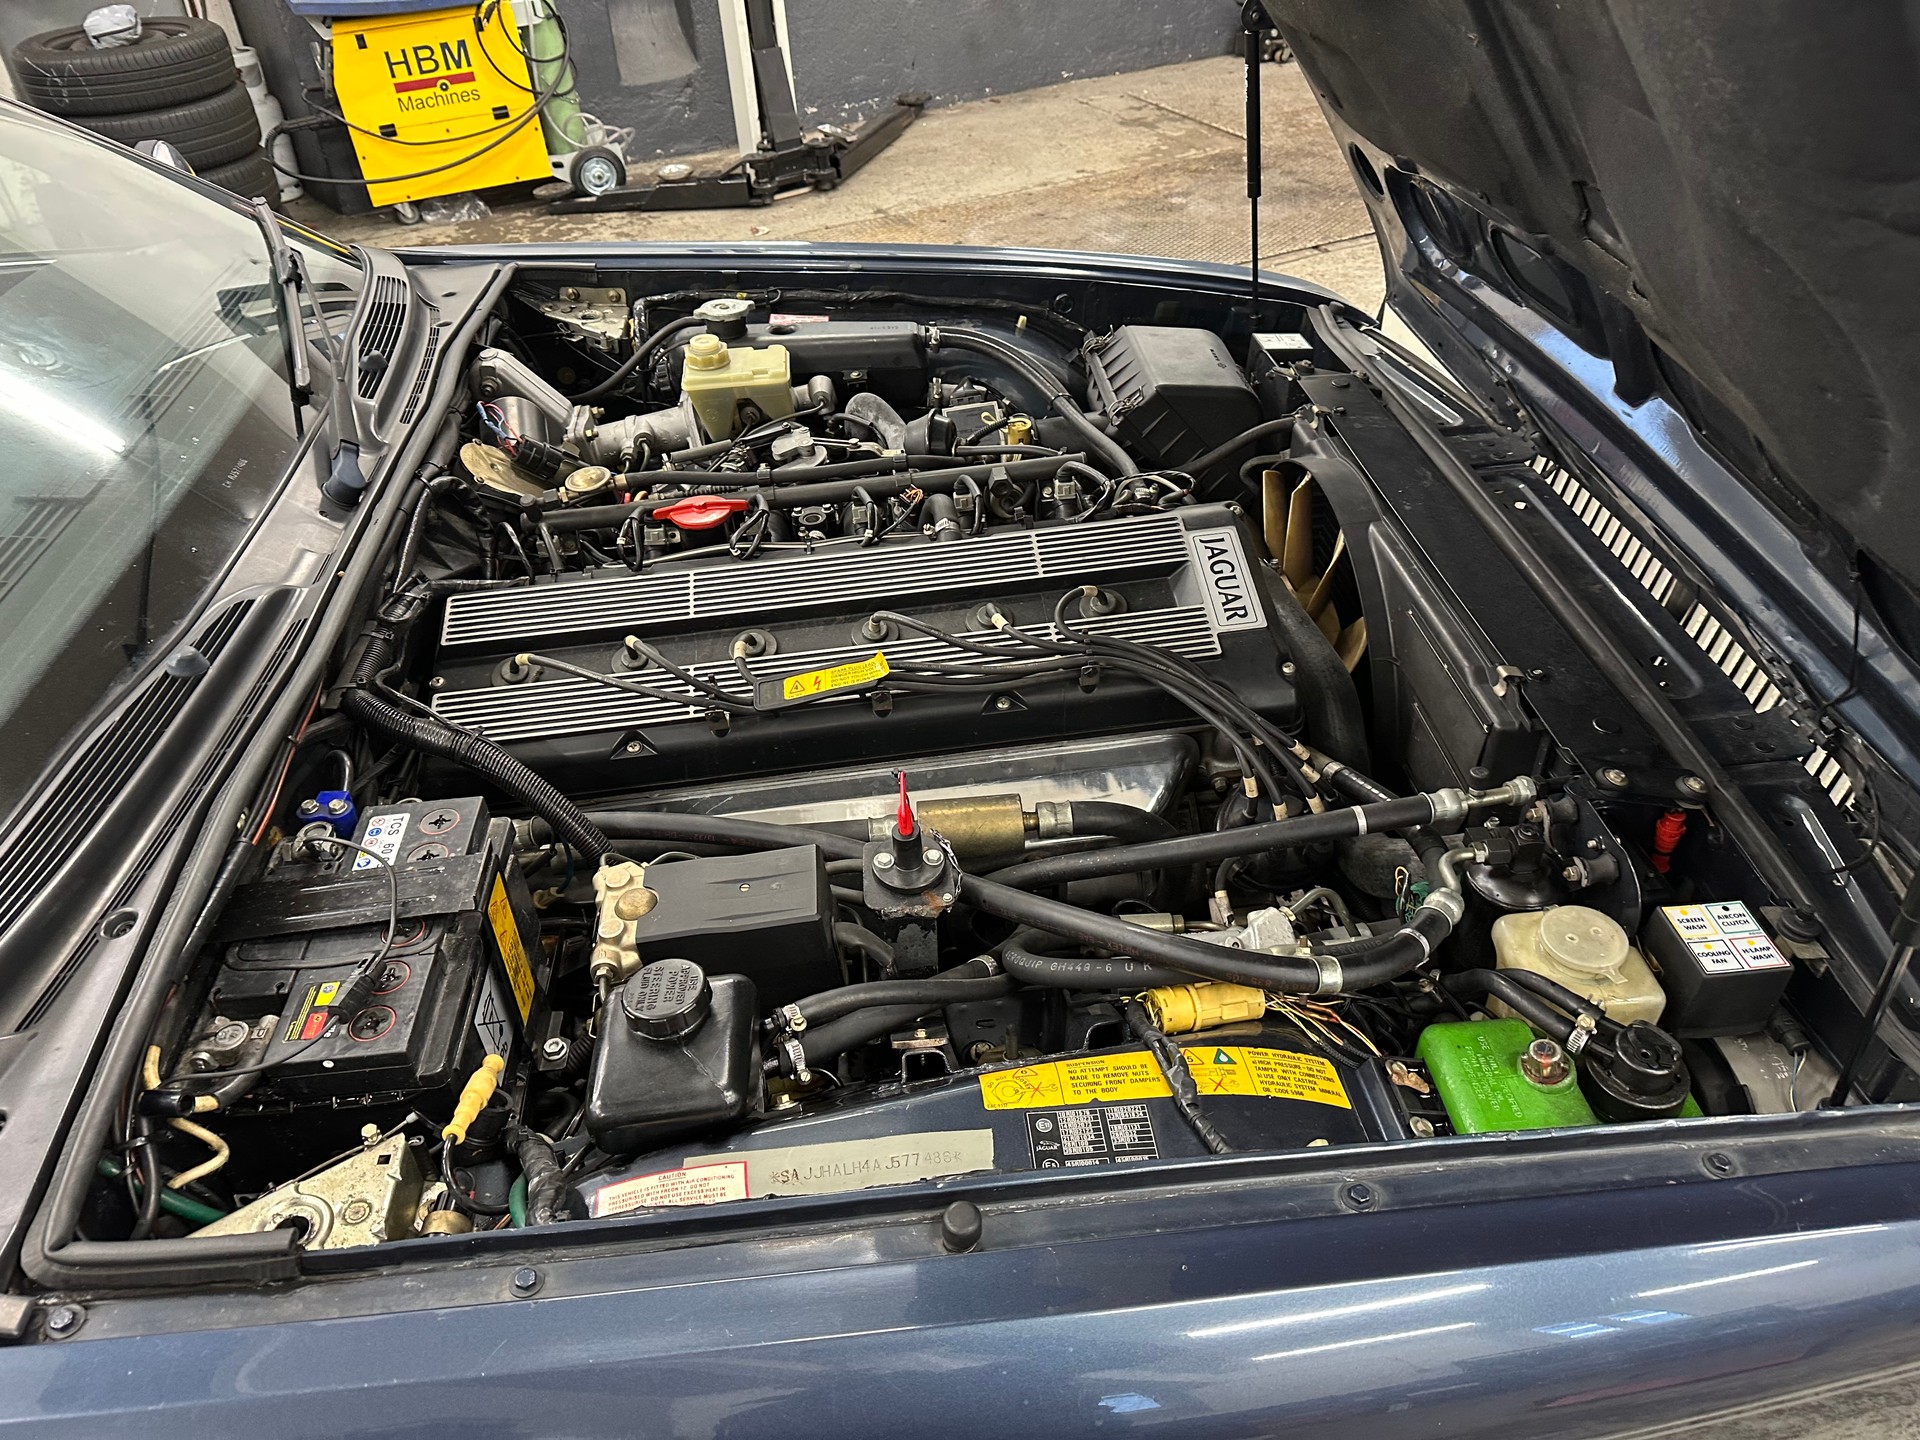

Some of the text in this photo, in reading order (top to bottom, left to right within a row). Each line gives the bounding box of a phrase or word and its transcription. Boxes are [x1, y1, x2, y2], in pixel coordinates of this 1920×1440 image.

[384, 39, 473, 79] HBM
[397, 86, 481, 113] Machines
[1198, 537, 1249, 622] JAGUAR
[387, 816, 405, 836] TCS
[381, 843, 395, 855] 60
[1721, 919, 1750, 927] CLUTCH
[1697, 950, 1731, 958] COOLING
[1750, 953, 1774, 961] WASH
[640, 967, 652, 989] FLUID
[646, 966, 664, 1011] STEERING
[663, 970, 679, 1003] POWER
[1478, 1036, 1491, 1050] USE
[1272, 1052, 1302, 1062] HYDRAULIC
[1304, 1057, 1326, 1066] SYSTEM
[1299, 1071, 1335, 1083] CONNECTIONS
[1071, 1080, 1102, 1088] SECURING
[1294, 1083, 1316, 1092] SYSTEM
[658, 1172, 687, 1180] CAUTION
[621, 1189, 642, 1197] VEHICLE
[650, 1182, 669, 1190] FITTED
[696, 1174, 734, 1182] CONDITIONING
[683, 1188, 704, 1196] EXCESS
[679, 1194, 702, 1202] SERVICE
